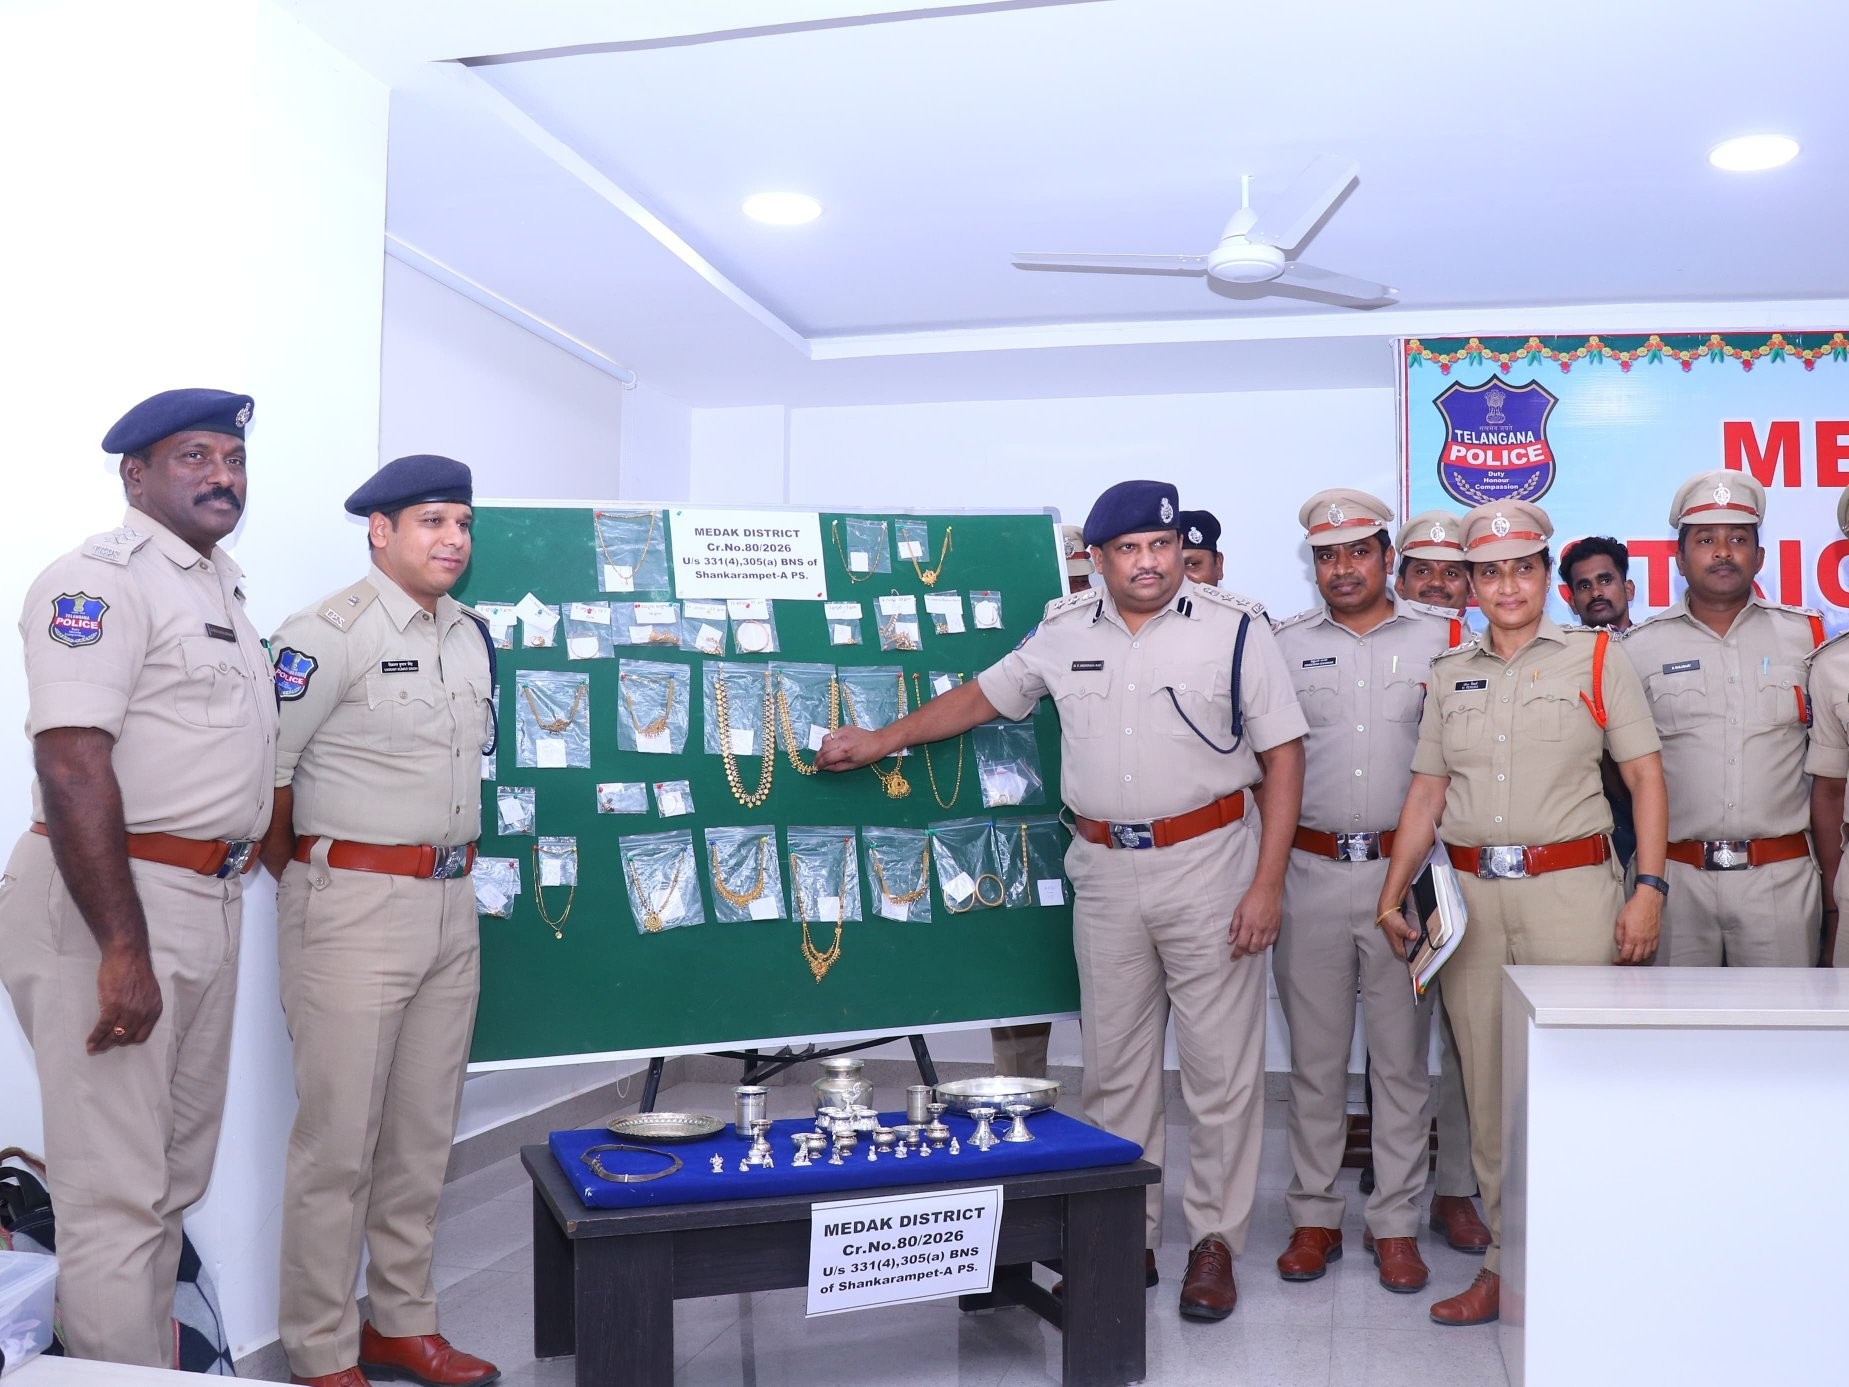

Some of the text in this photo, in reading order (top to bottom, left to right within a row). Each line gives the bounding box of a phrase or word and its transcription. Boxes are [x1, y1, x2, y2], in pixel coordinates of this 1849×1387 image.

[1454, 429, 1536, 445] TELANGANA
[1449, 444, 1545, 466] POLICE
[694, 528, 800, 538] MEDAK DISTRICT
[707, 543, 792, 552] Cr.No.80/2026
[682, 557, 818, 567] U/s 331(4),305(a) BNS of
[695, 571, 809, 581] Shankarampet-A PS.
[56, 617, 99, 629] POLICE
[276, 668, 305, 685] POLICE
[824, 1207, 985, 1237] MEDAK DISTRICT
[842, 1230, 964, 1256] Cr.No.80/2026
[823, 1246, 979, 1277] U/s 331(4),305(a) BNS
[820, 1263, 978, 1294] of Shankarampet-A PS.
